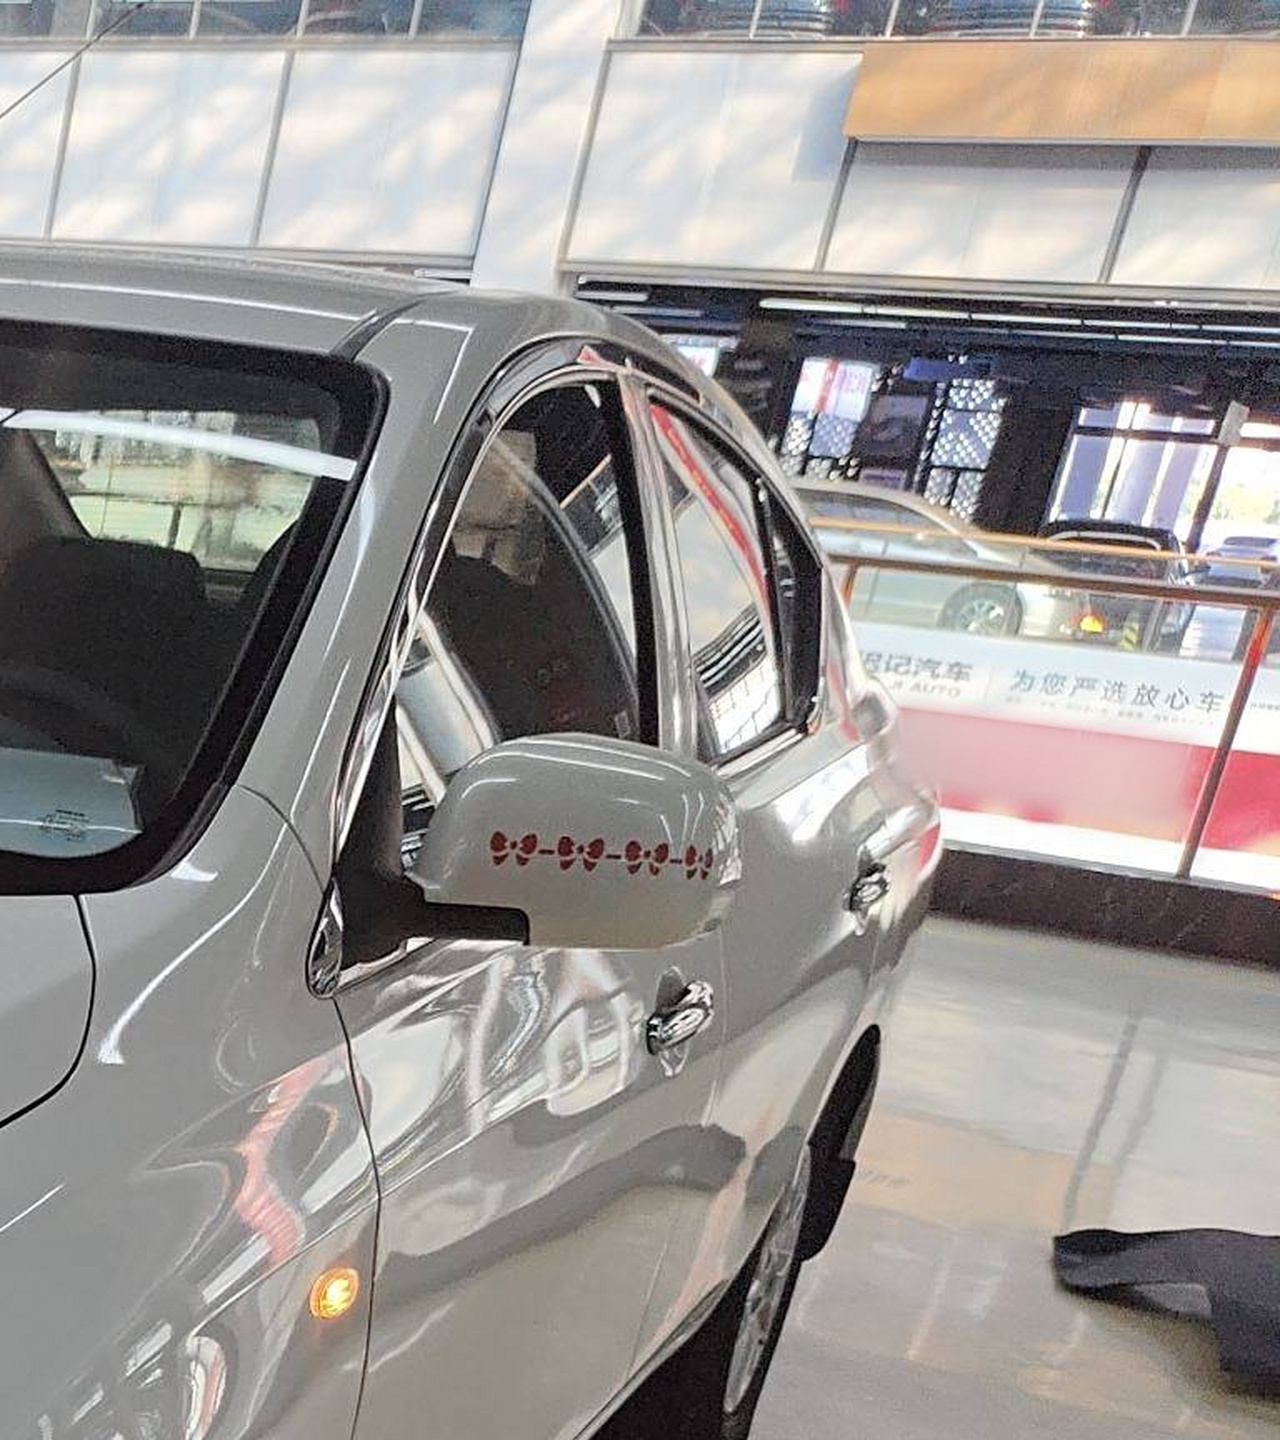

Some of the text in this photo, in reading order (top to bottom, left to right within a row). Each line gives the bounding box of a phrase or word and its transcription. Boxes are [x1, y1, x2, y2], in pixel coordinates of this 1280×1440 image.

[1010, 668, 1225, 714] 为您严选放心车
